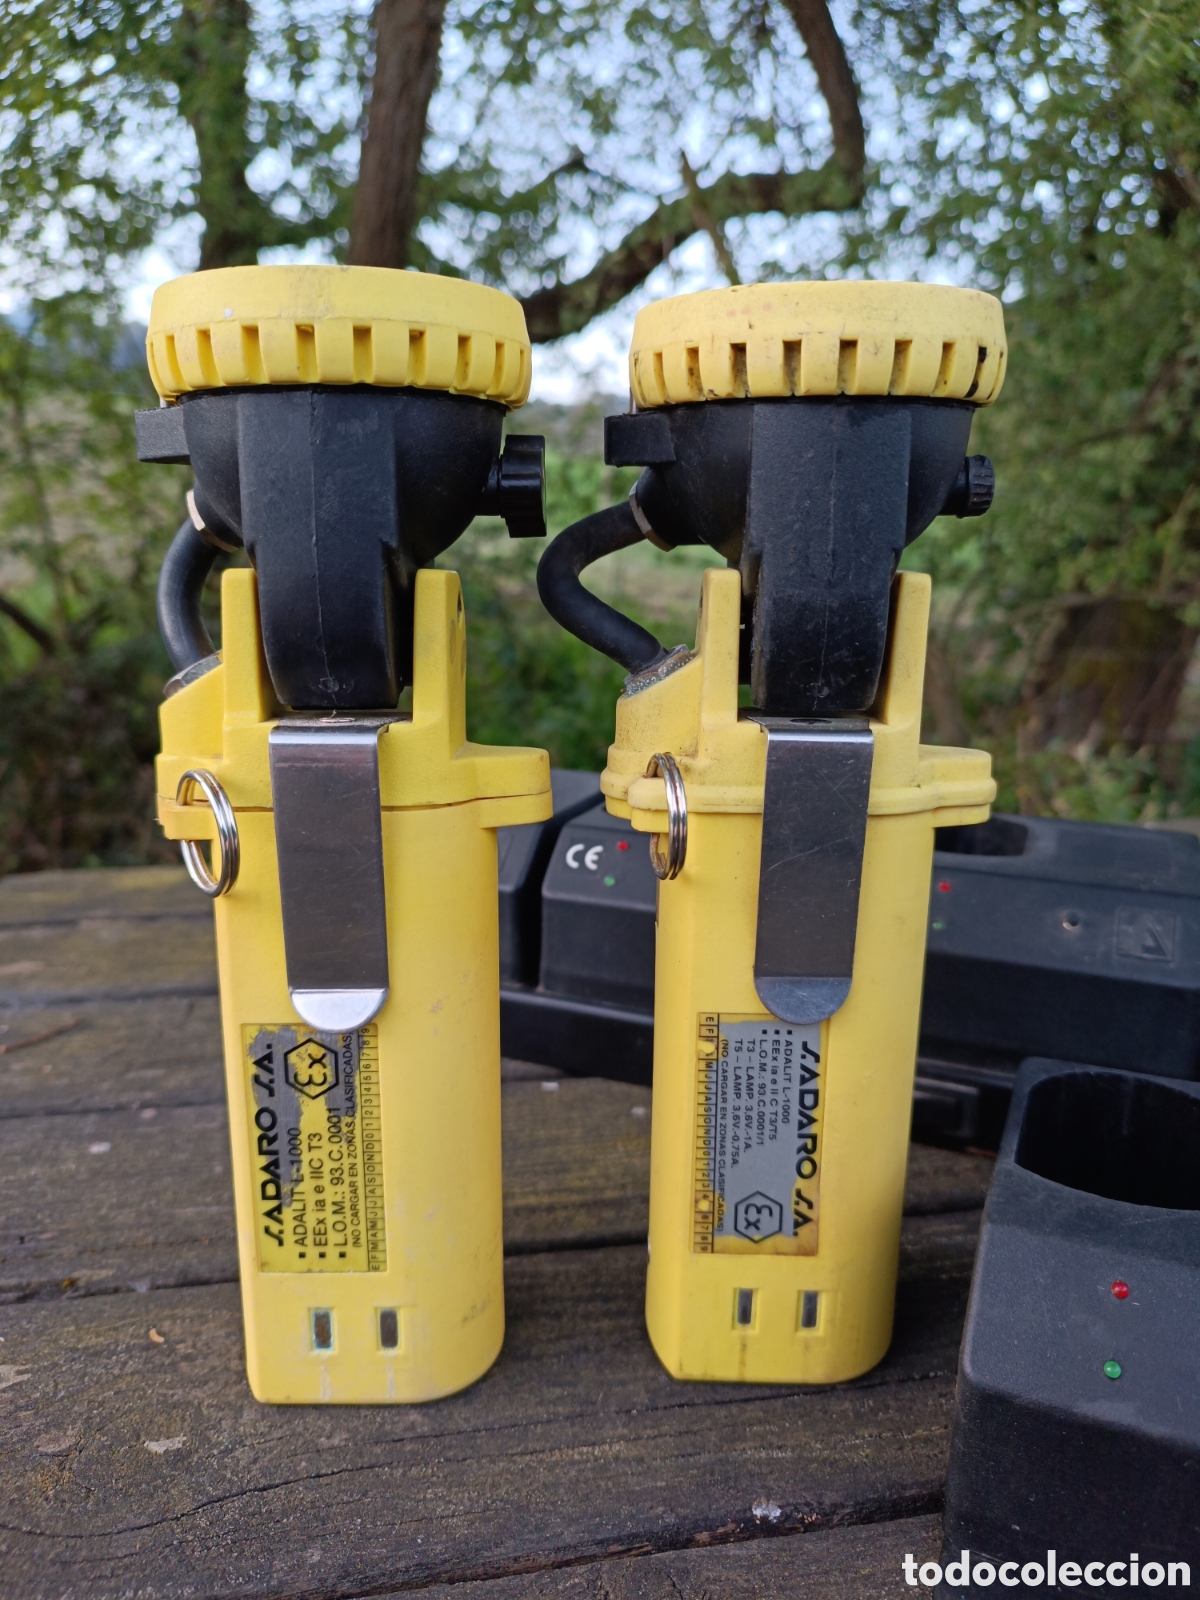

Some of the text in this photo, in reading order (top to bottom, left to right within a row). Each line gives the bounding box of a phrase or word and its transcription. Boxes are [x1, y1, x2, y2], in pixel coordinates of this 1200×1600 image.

[566, 843, 604, 871] CE
[735, 1038, 743, 1052] T5
[747, 1039, 755, 1052] T3
[771, 1040, 780, 1062] EEx
[733, 1067, 742, 1102] LAMP.
[745, 1067, 755, 1102] LAMP.
[771, 1066, 779, 1075] ia
[781, 1040, 793, 1124] ADALIT L-1000
[756, 1040, 768, 1146] L.O.M.: 93.C.0001/1
[770, 1098, 778, 1107] C
[345, 1122, 357, 1159] ZONAS
[715, 1039, 729, 1232] (NO CARGAR EN ZONAS CLASIFICADAS)
[769, 1110, 778, 1140] T3/T5
[287, 1128, 308, 1247] ADALIT L-1000
[327, 1108, 348, 1247] L.O.M.: 93.C.0001
[348, 1163, 358, 1177] EN
[308, 1132, 328, 1247] EEx ia e IIC T3
[349, 1181, 360, 1226] CARGAR
[351, 1229, 363, 1248] (NO
